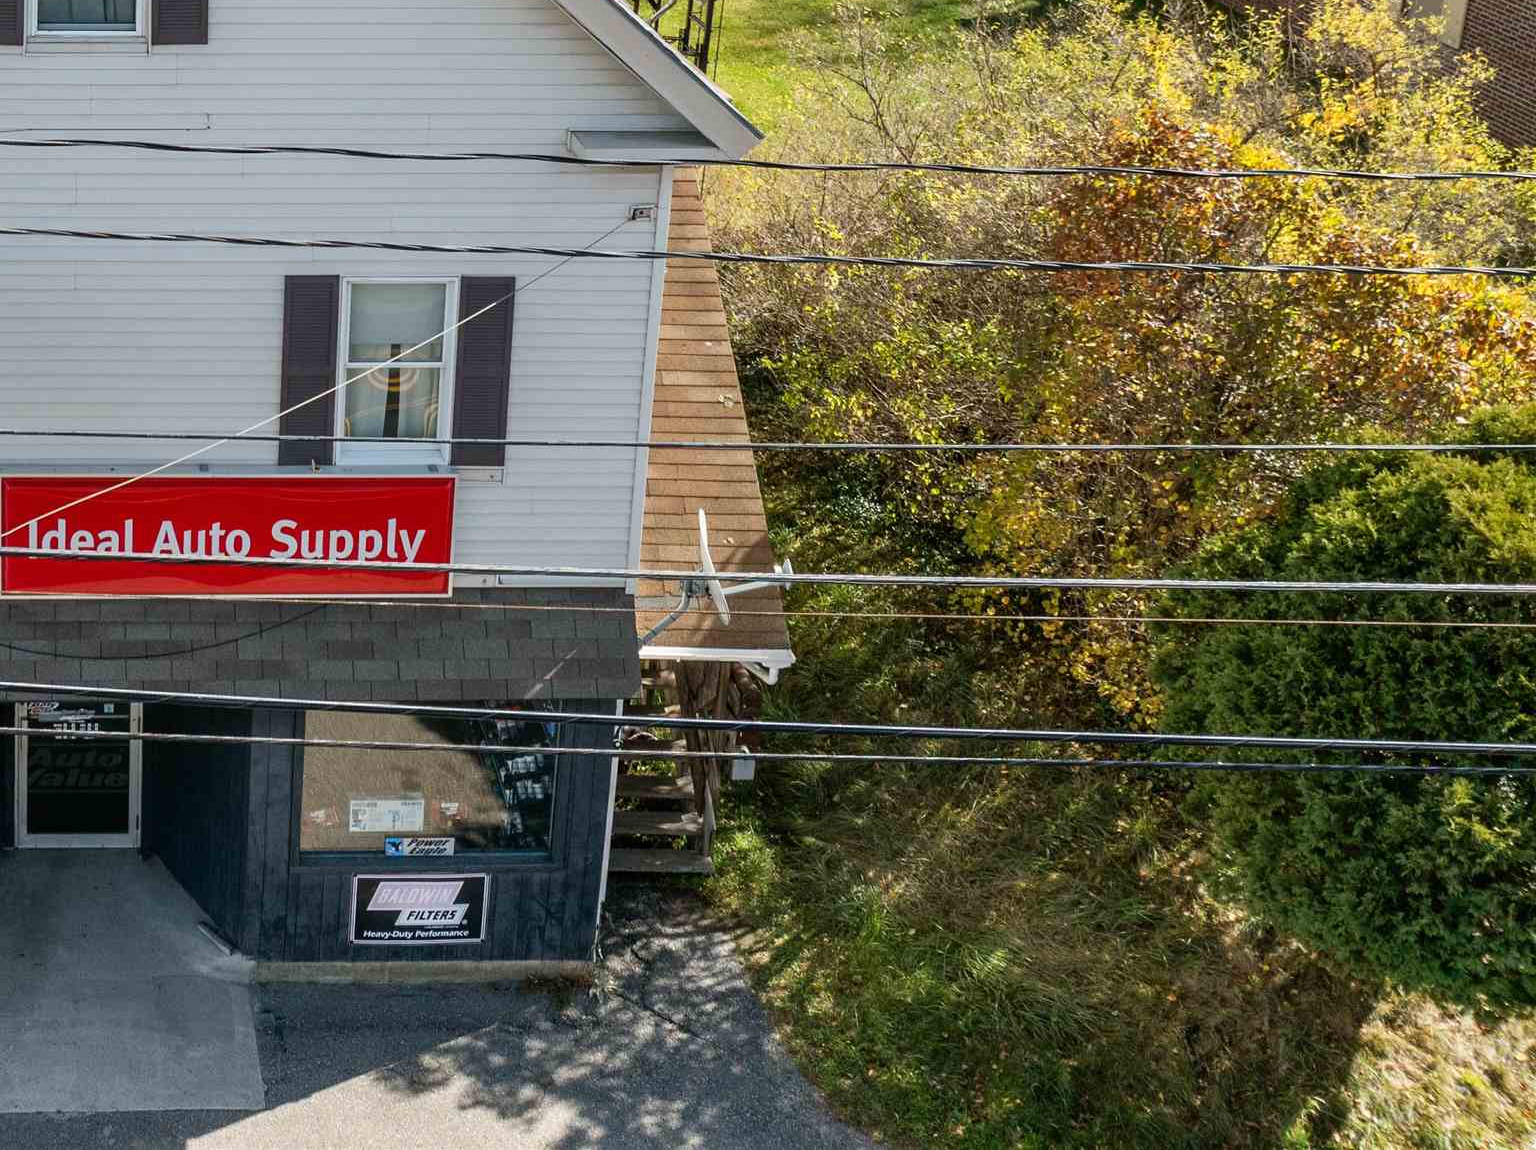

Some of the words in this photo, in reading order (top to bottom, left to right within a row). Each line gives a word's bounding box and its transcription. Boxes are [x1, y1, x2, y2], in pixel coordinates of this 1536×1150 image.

[27, 518, 135, 559] Ideal
[152, 519, 252, 559] Auto
[270, 518, 426, 569] Supply
[377, 888, 455, 905] BALDWIN
[407, 910, 457, 921] FILTERS
[363, 930, 414, 939] Heavy-Duty
[415, 929, 469, 939] Performance
